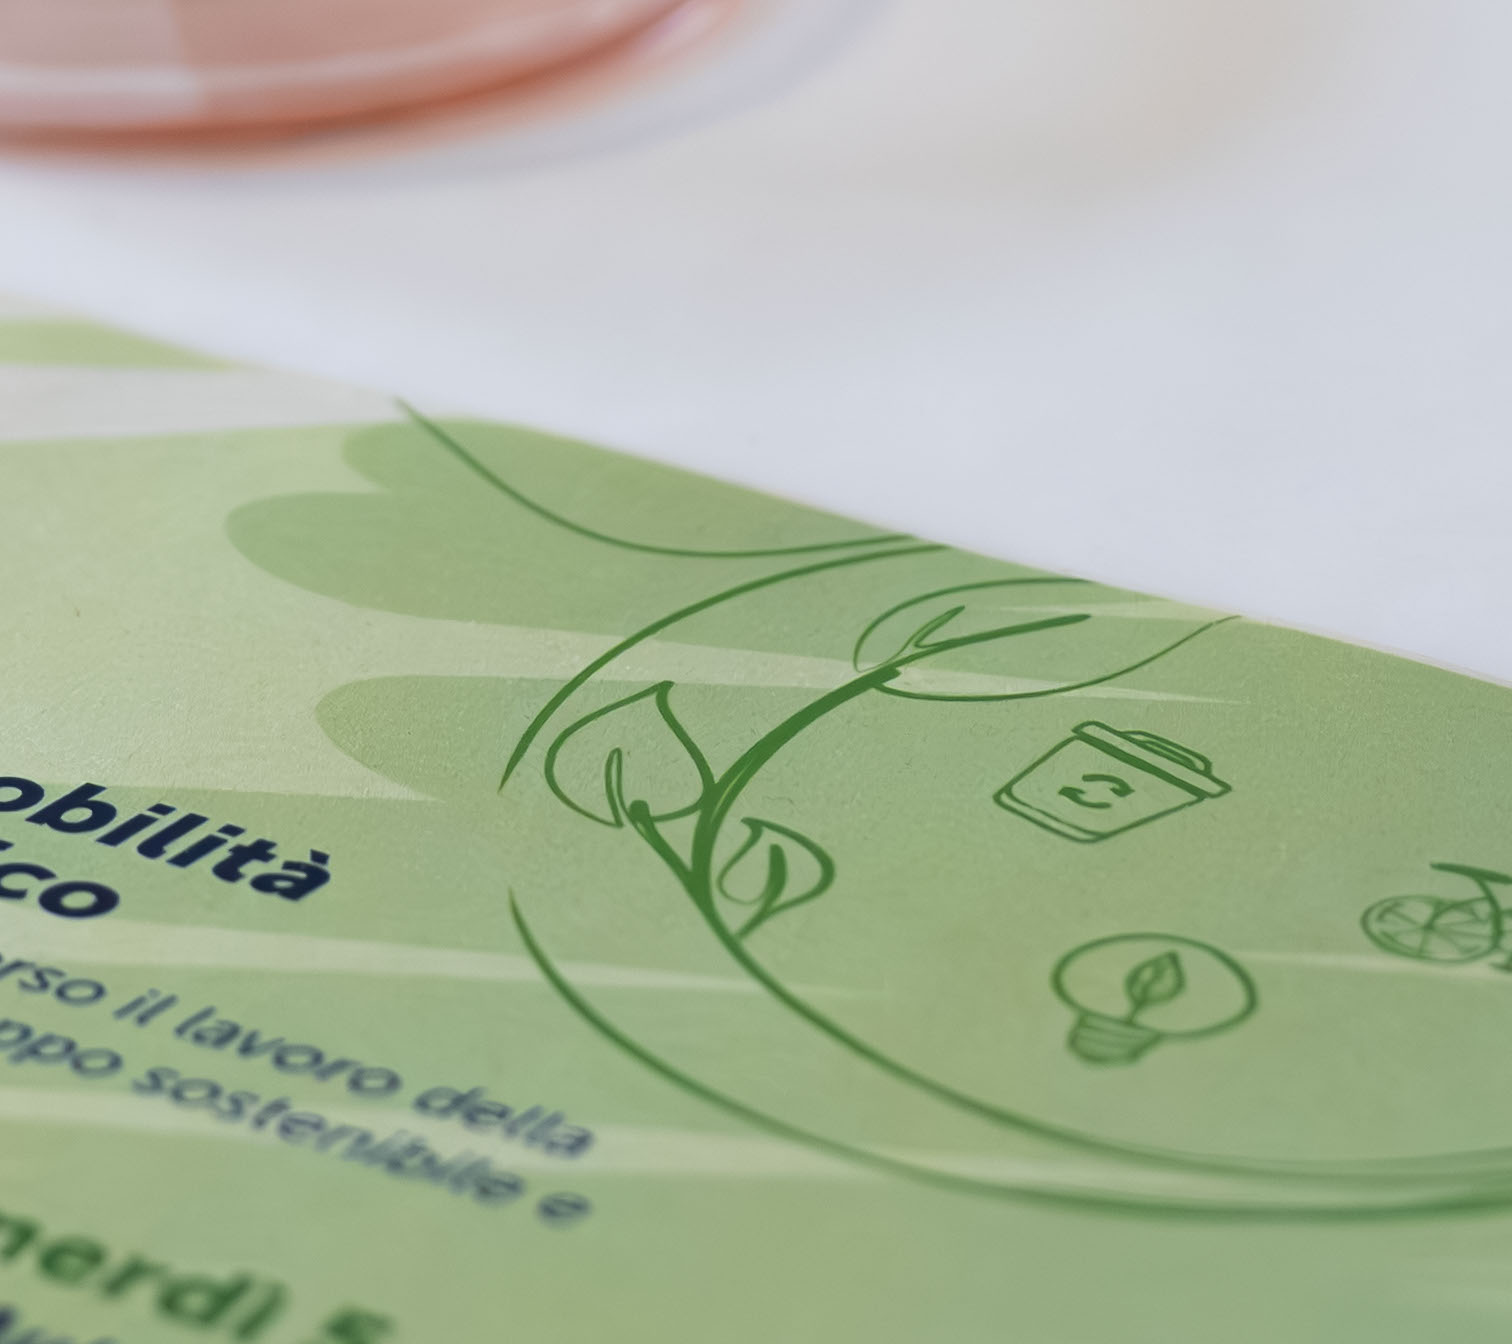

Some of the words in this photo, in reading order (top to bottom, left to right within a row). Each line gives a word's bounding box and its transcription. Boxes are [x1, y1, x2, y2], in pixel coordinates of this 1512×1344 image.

[112, 988, 178, 1027] il
[172, 1006, 403, 1099] lavoro
[412, 1084, 596, 1161] della
[130, 1064, 526, 1208] sostenibile
[534, 1190, 595, 1229] e
